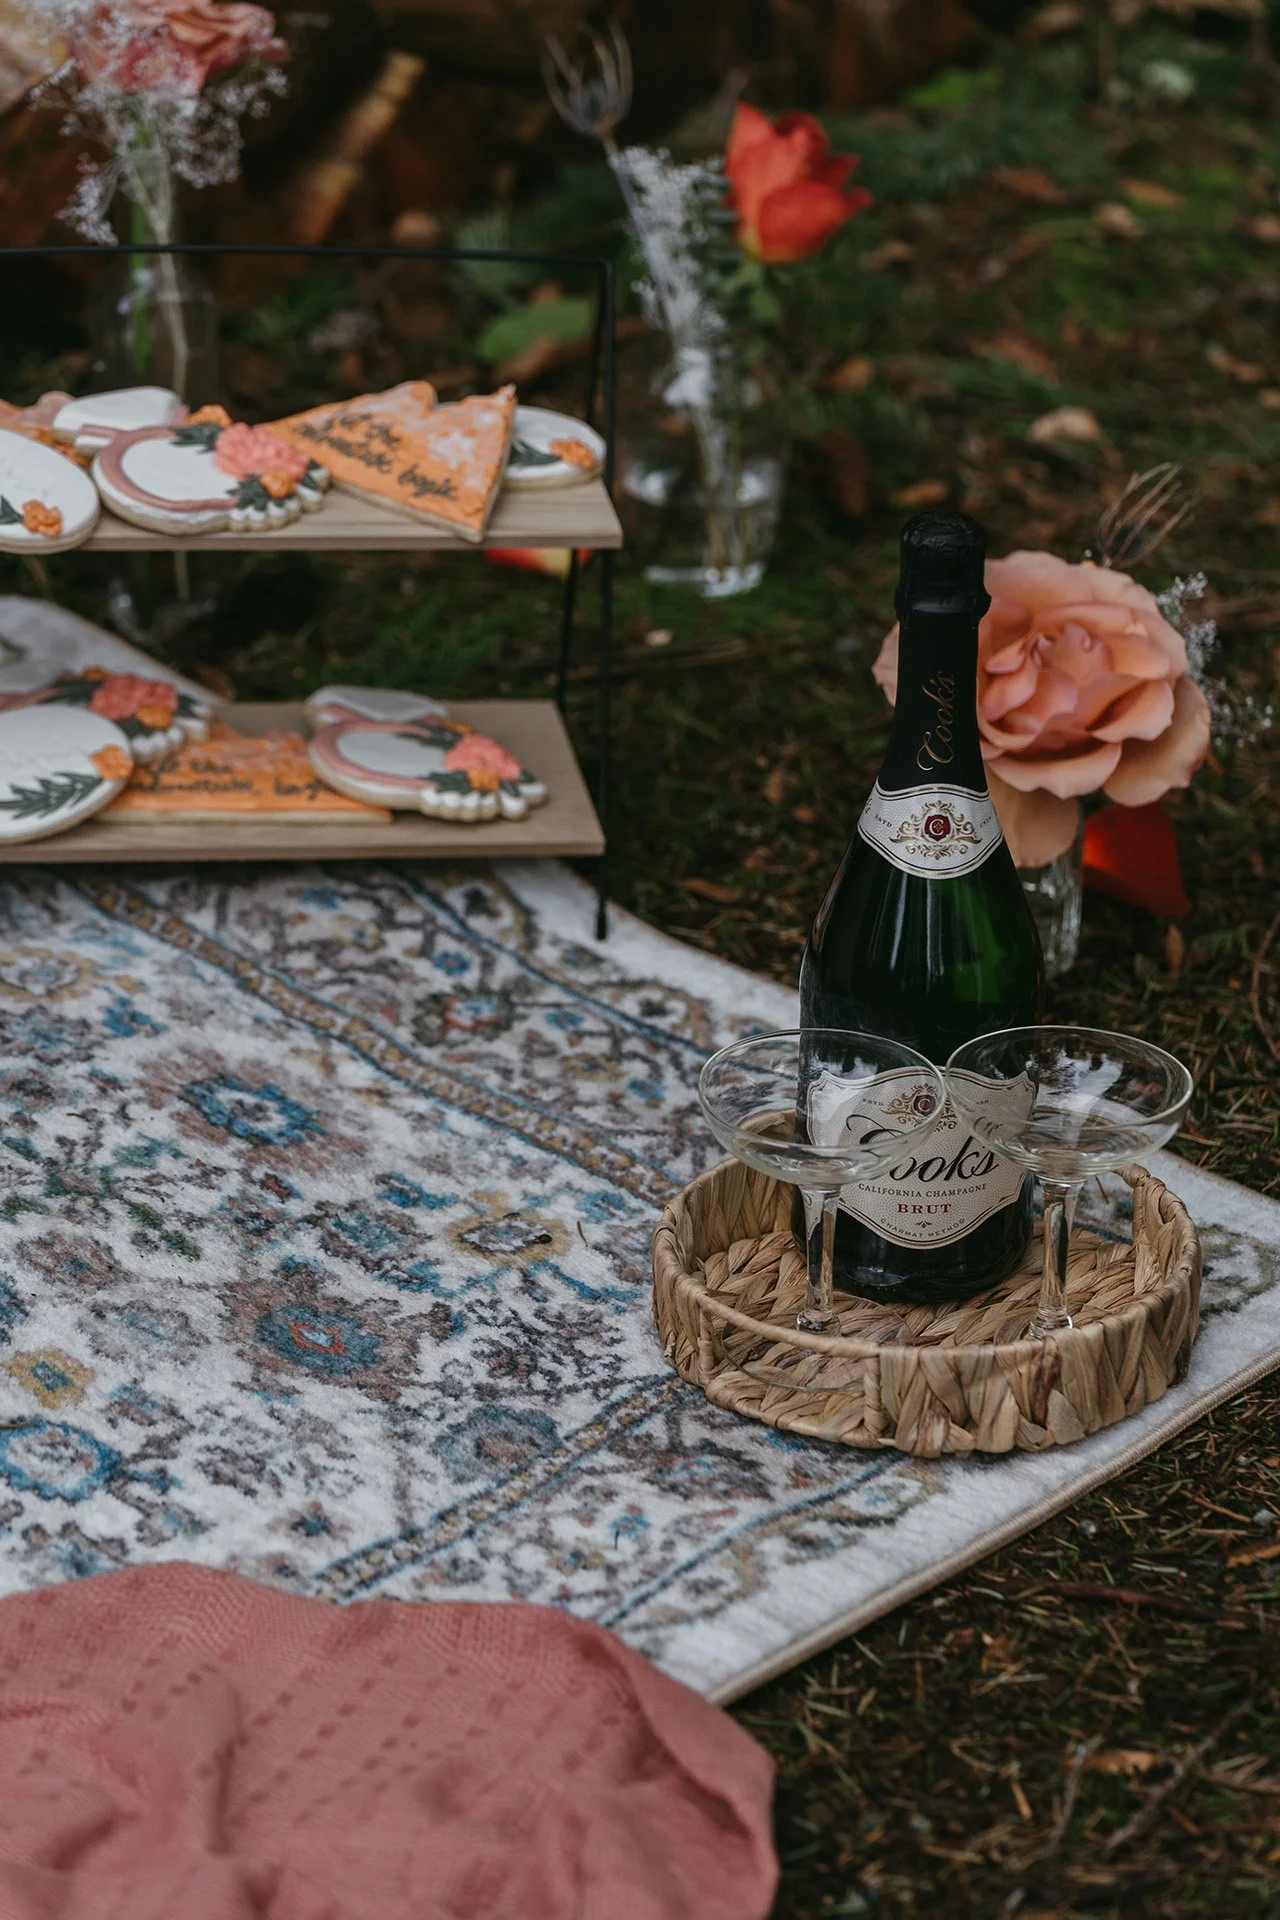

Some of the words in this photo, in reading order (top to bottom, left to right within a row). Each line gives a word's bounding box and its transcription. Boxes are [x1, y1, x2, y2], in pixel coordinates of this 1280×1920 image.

[858, 1182, 922, 1198] CALIFORNIA
[926, 1182, 988, 1198] CHAMPAGNE
[896, 1203, 952, 1214] BRUT
[880, 1218, 923, 1238] CHARMAT
[927, 1218, 965, 1238] METHOD
